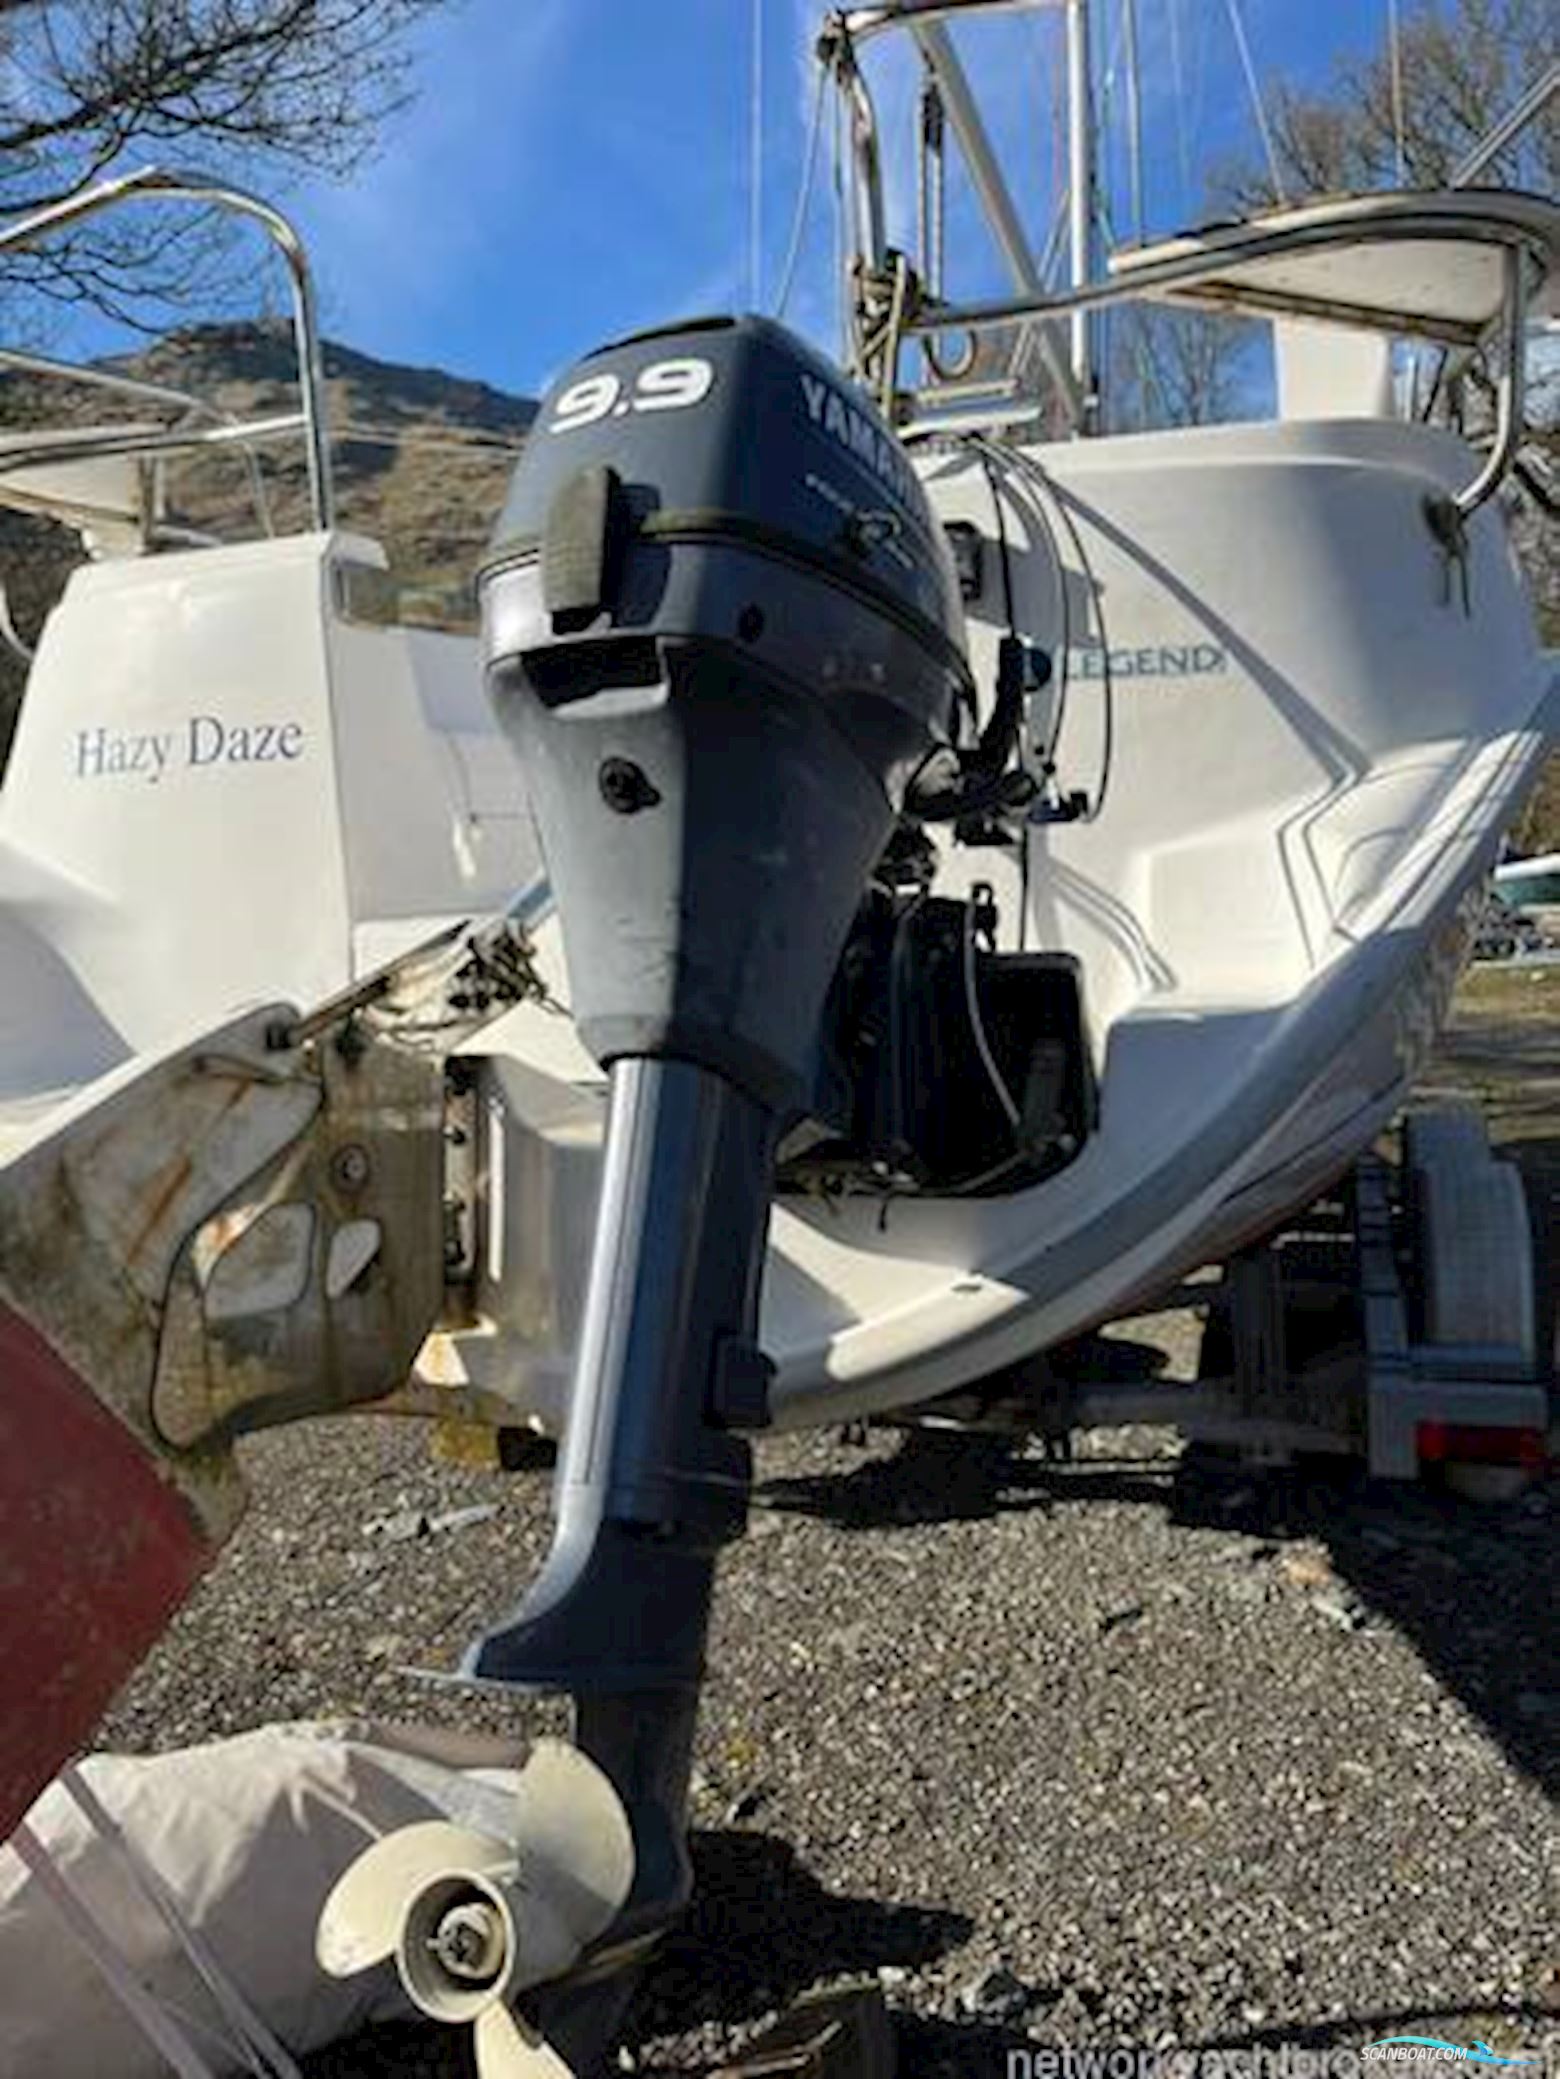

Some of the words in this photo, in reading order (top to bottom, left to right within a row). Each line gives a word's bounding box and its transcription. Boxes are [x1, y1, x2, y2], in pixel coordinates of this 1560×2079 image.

[550, 358, 713, 434] 9.9
[76, 728, 172, 783] Hazy
[189, 715, 303, 766] Daze
